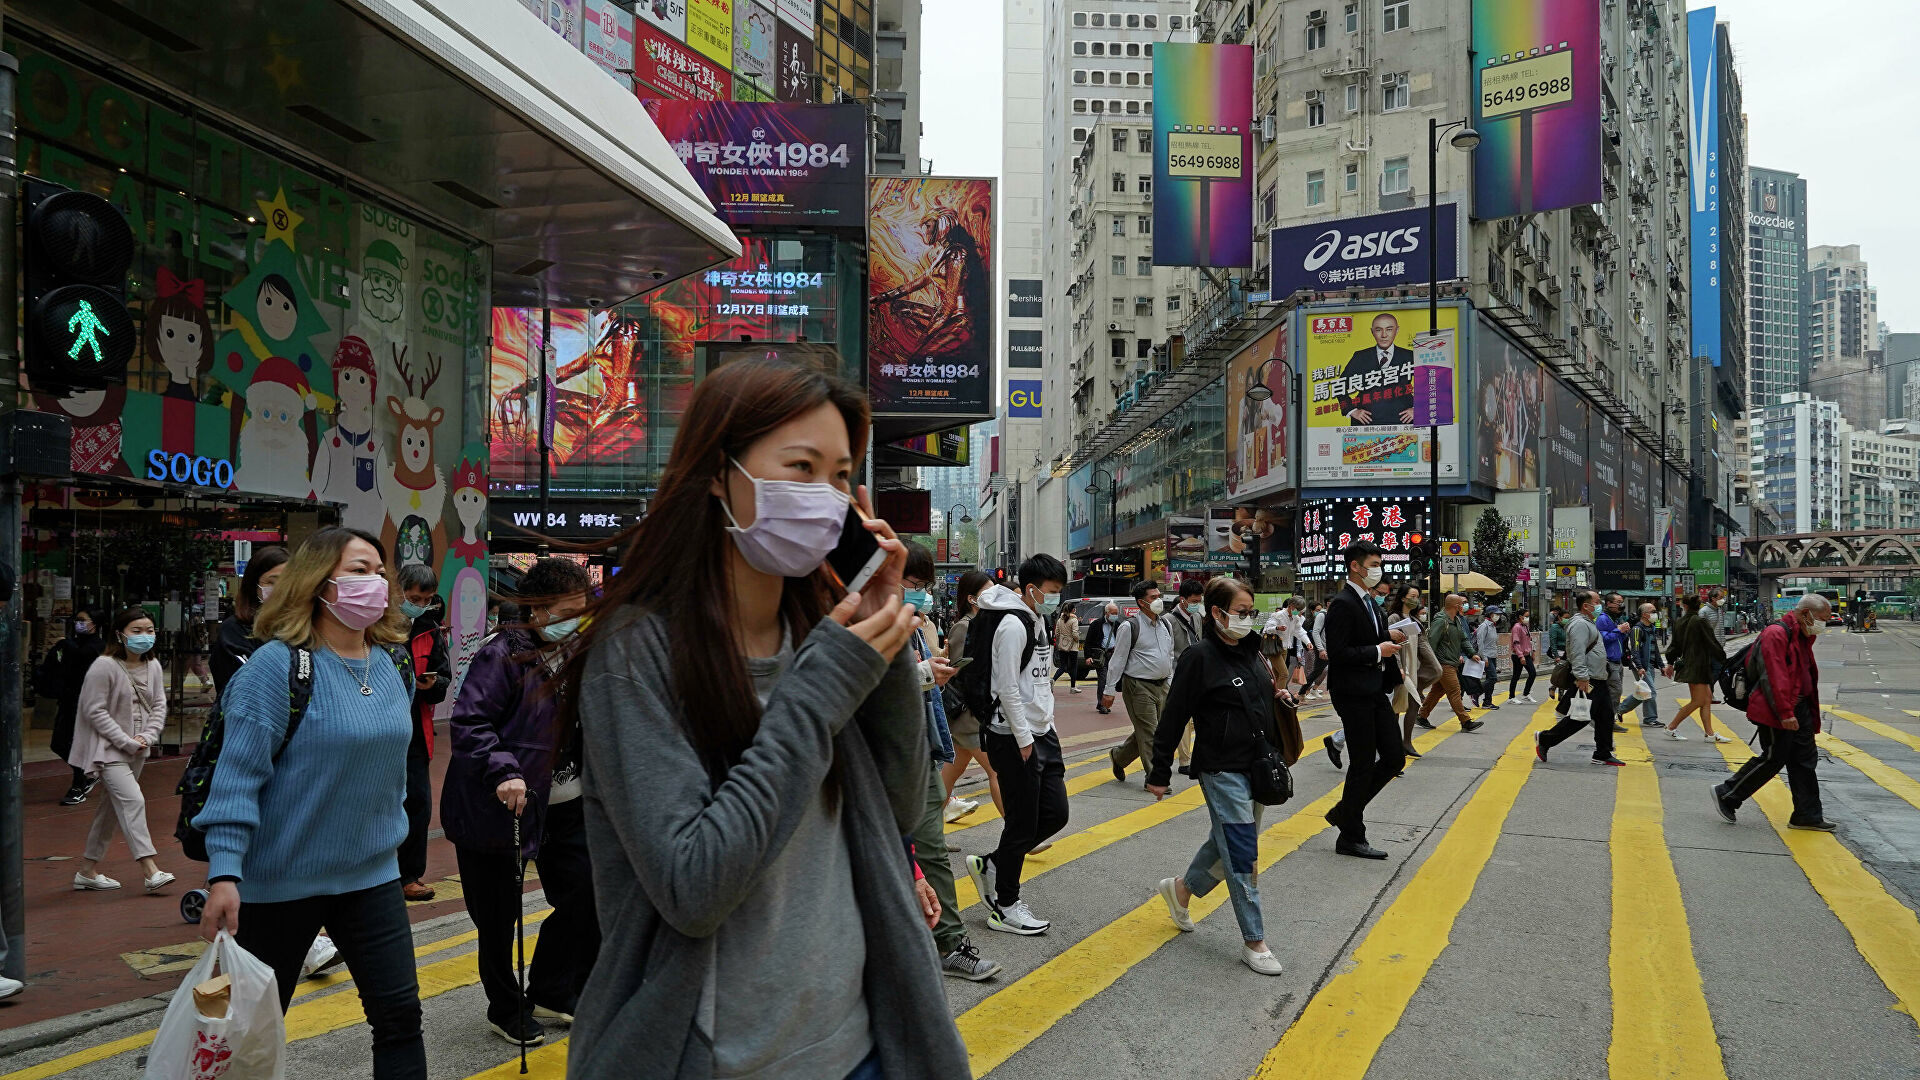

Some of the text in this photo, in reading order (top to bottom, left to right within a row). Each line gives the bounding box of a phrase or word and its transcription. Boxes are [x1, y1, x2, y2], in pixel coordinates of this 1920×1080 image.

[670, 2, 684, 18] 5/F
[719, 22, 730, 37] 5/F
[657, 41, 718, 91] 麻辣派對
[1483, 76, 1571, 109] 5649 6988
[752, 127, 765, 140] DC
[671, 139, 850, 168] 神奇女俠1984
[1170, 154, 1240, 169] 5649 6988
[708, 167, 808, 177] WONDER WOMAN 1984
[731, 193, 785, 203] 12月 願望成真
[363, 203, 410, 237] SOGO
[1748, 211, 1795, 230] Rosedale
[704, 270, 823, 289] 神奇女俠1984
[1328, 261, 1405, 284] 崇光百貨4樓
[1010, 294, 1042, 302] ershka
[716, 304, 809, 316] 12月17日 願望成真
[1316, 318, 1348, 330] 馬百良
[880, 363, 980, 379] 神奇女俠1984
[1312, 361, 1414, 402] 馬百良安宮牛
[909, 389, 923, 397] 12月
[1010, 389, 1042, 408] GU
[148, 448, 234, 488] SOGO
[1352, 504, 1406, 528] 香港
[1095, 564, 1123, 572] LUSH
